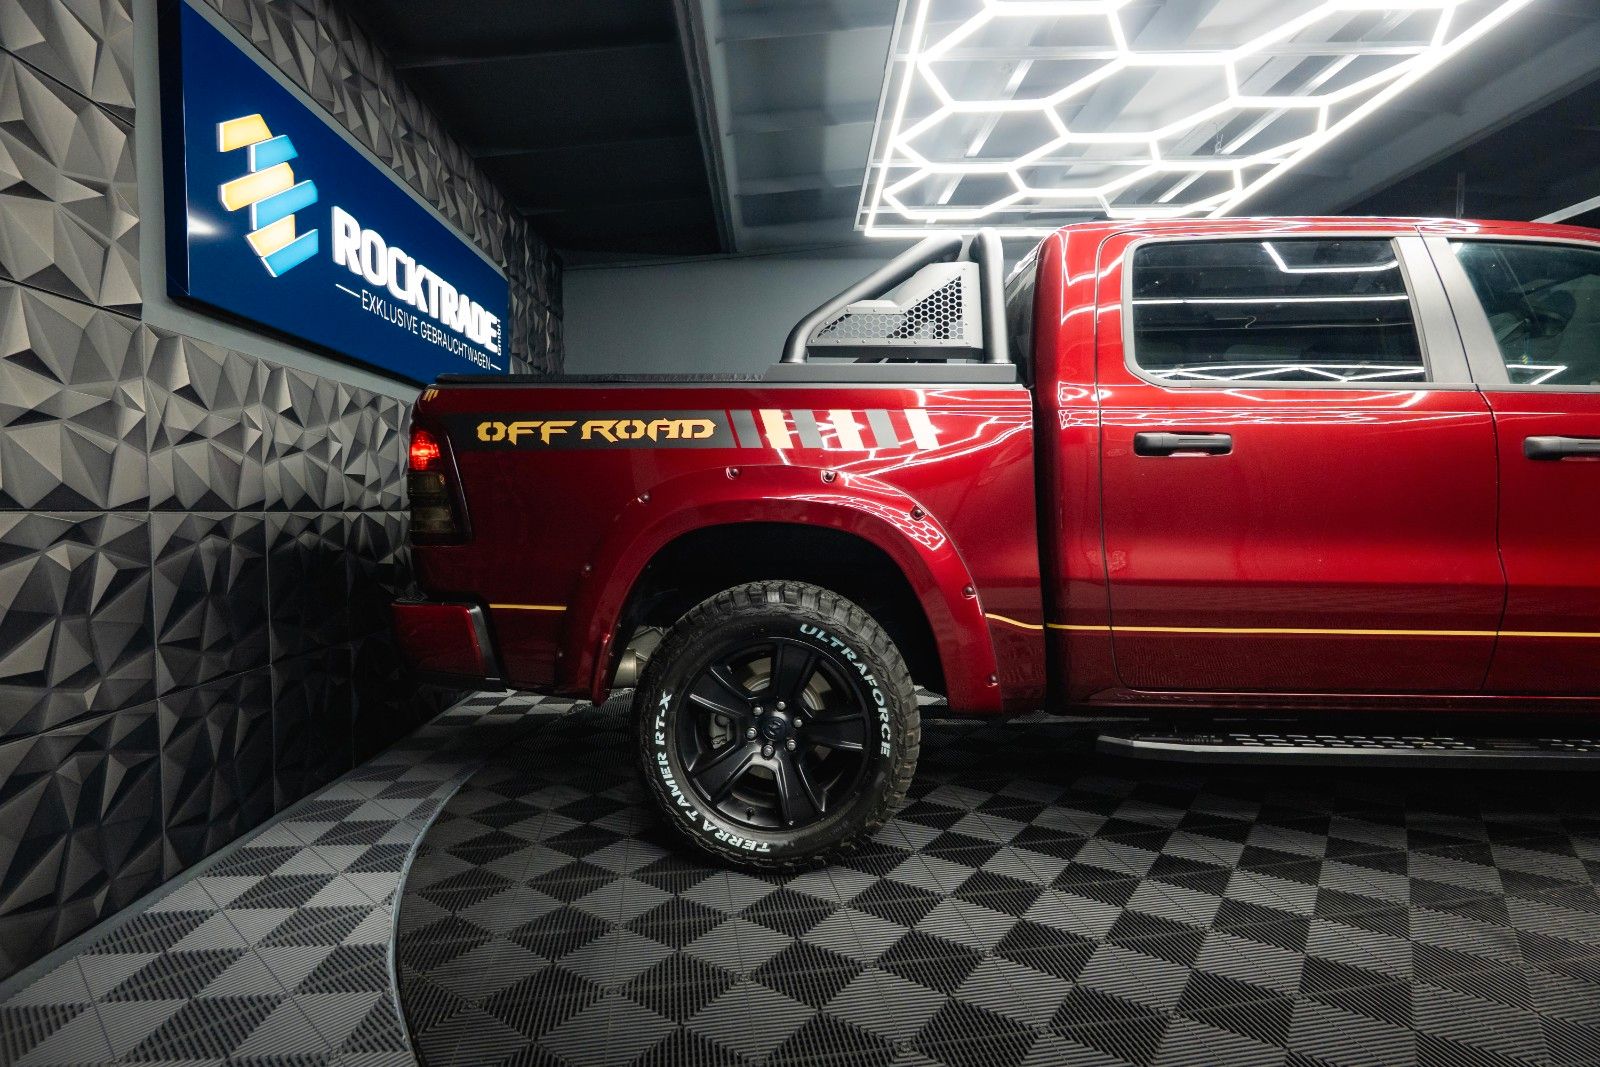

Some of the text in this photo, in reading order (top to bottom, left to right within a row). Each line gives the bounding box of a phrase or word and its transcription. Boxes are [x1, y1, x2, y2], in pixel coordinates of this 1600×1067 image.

[331, 206, 498, 354] ROCKTRADE
[361, 289, 491, 370] EXKLUSIVE GEBRAUCHTWAGEN
[476, 418, 717, 446] OFF ROAD
[800, 623, 891, 758] ULTRAFORCE
[654, 689, 771, 853] TERRA TAMER RT-X
